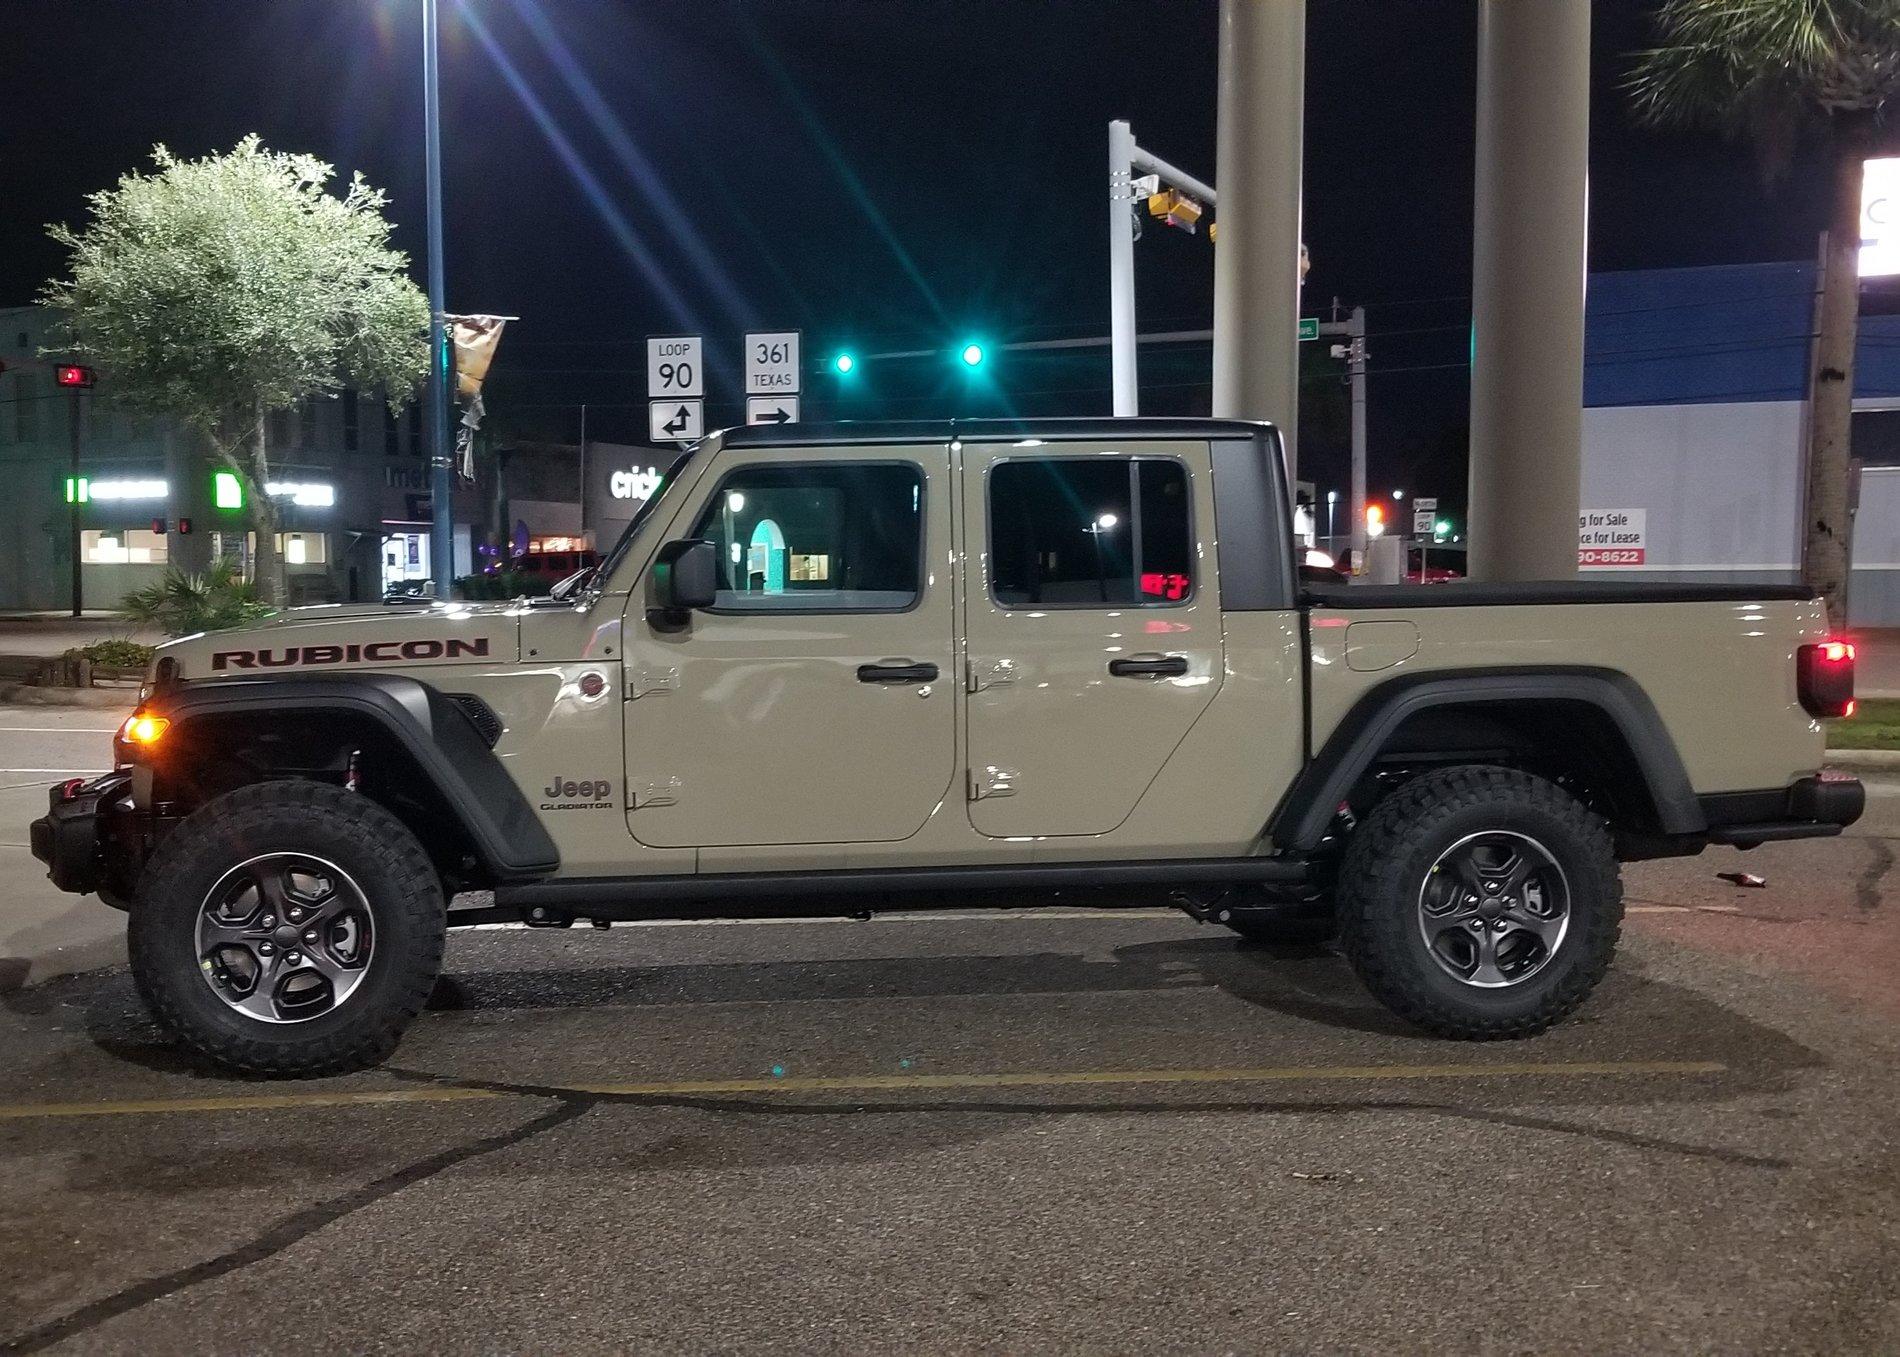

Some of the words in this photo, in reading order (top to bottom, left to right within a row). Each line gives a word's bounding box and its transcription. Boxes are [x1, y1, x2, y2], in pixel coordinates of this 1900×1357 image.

[659, 343, 691, 357] LOOP
[756, 343, 789, 364] 361
[658, 362, 693, 389] 90
[753, 373, 792, 387] TEXAS
[1416, 521, 1432, 531] 90
[1589, 513, 1604, 526] for
[1606, 513, 1628, 526] Sale
[1581, 534, 1592, 544] ce
[1594, 531, 1609, 544] for
[1611, 531, 1640, 544] Lease
[212, 637, 489, 671] RUBICON
[544, 776, 612, 801] Jeep
[540, 802, 614, 811] GLADIATOR
